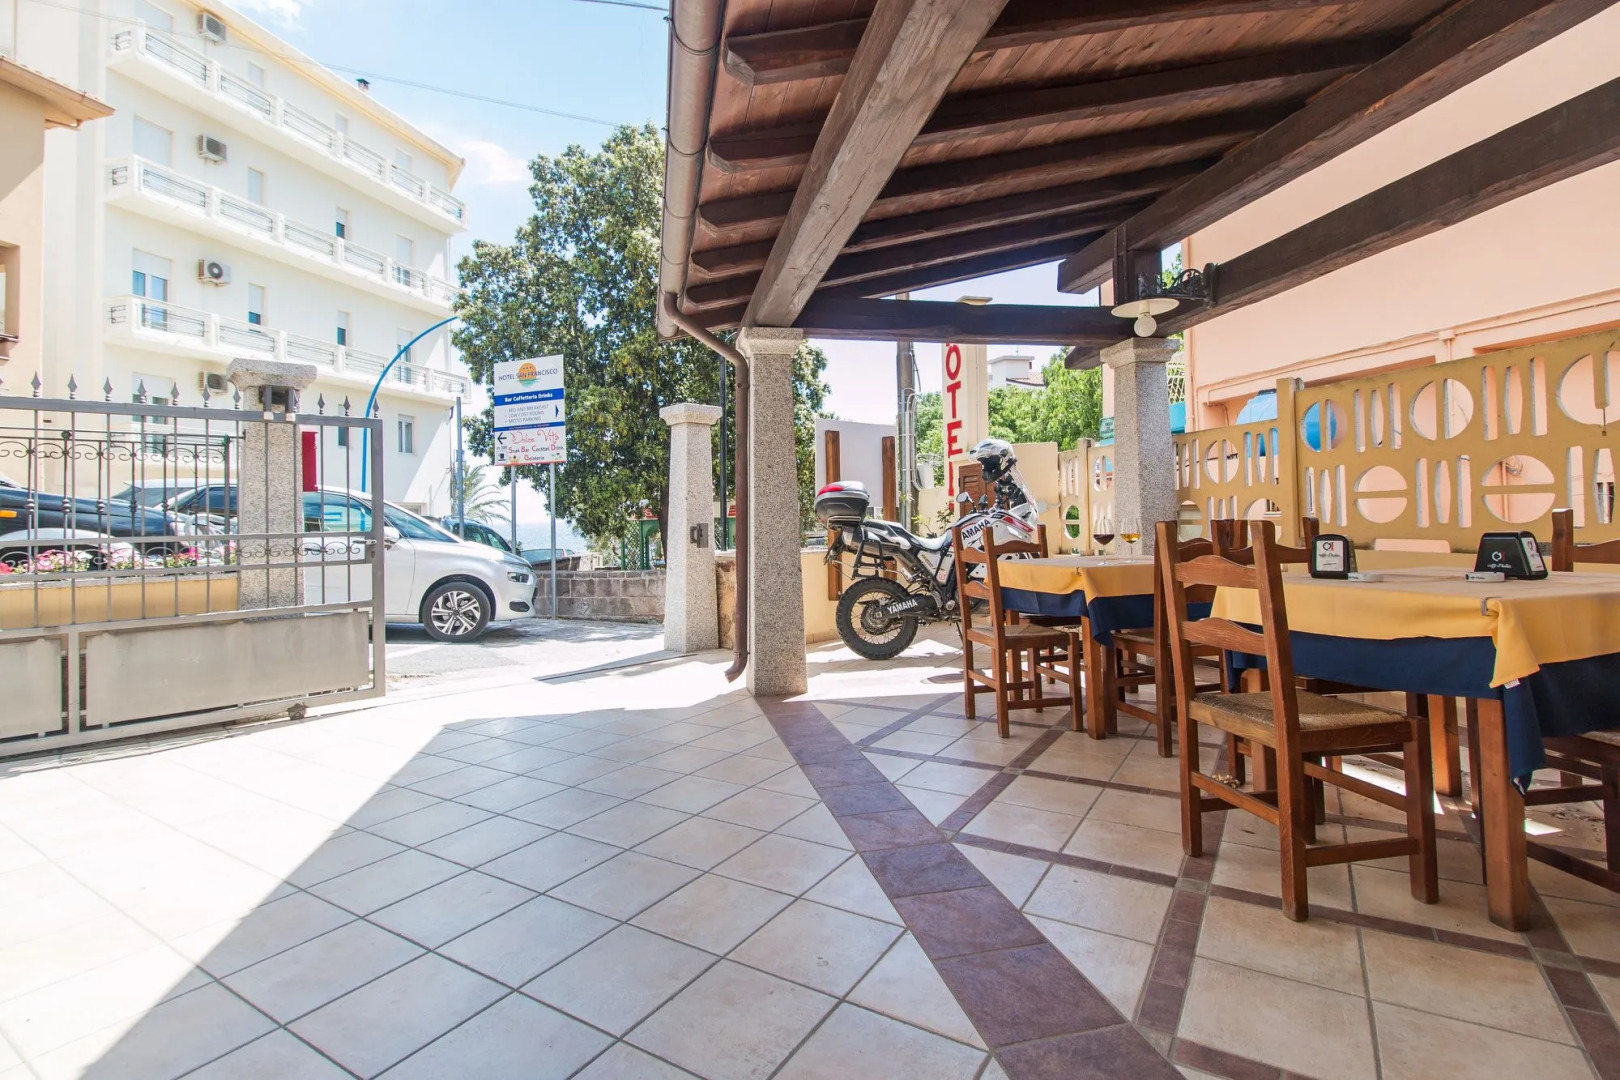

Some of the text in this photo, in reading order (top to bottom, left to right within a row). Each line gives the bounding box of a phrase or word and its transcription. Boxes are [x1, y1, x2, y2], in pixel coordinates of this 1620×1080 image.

[528, 368, 558, 377] FRANCISCO
[962, 519, 990, 540] AMAHA
[887, 599, 918, 614] YAMAHA
